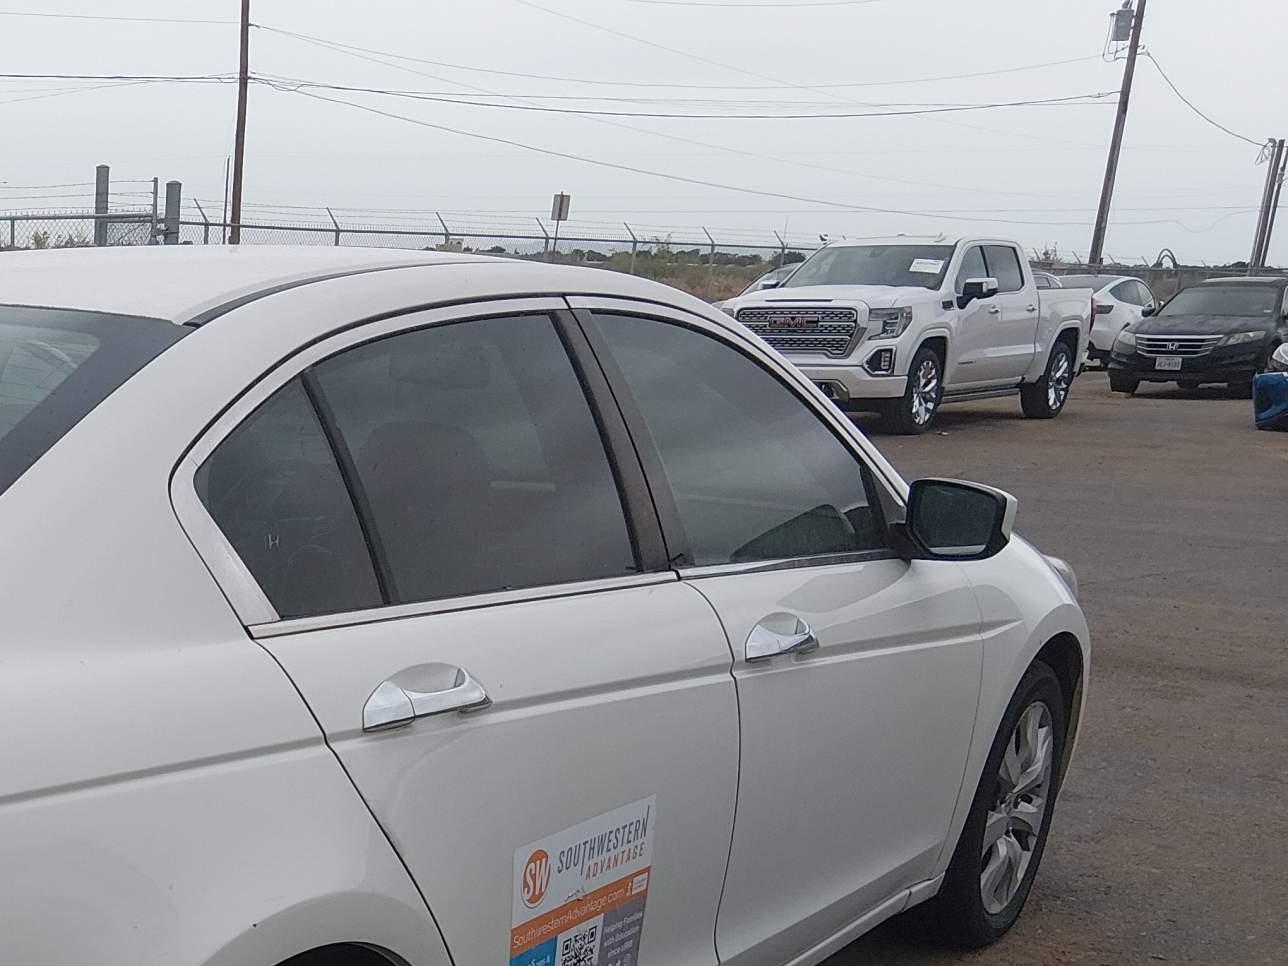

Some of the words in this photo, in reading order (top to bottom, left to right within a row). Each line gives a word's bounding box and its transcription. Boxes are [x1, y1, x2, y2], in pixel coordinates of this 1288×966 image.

[769, 316, 819, 329] GMC
[557, 805, 650, 876] SOUTHWESTERN
[585, 842, 645, 880] ADVANTAGE
[524, 857, 551, 901] SW
[512, 887, 625, 949] SouthwesternAdvantage.com
